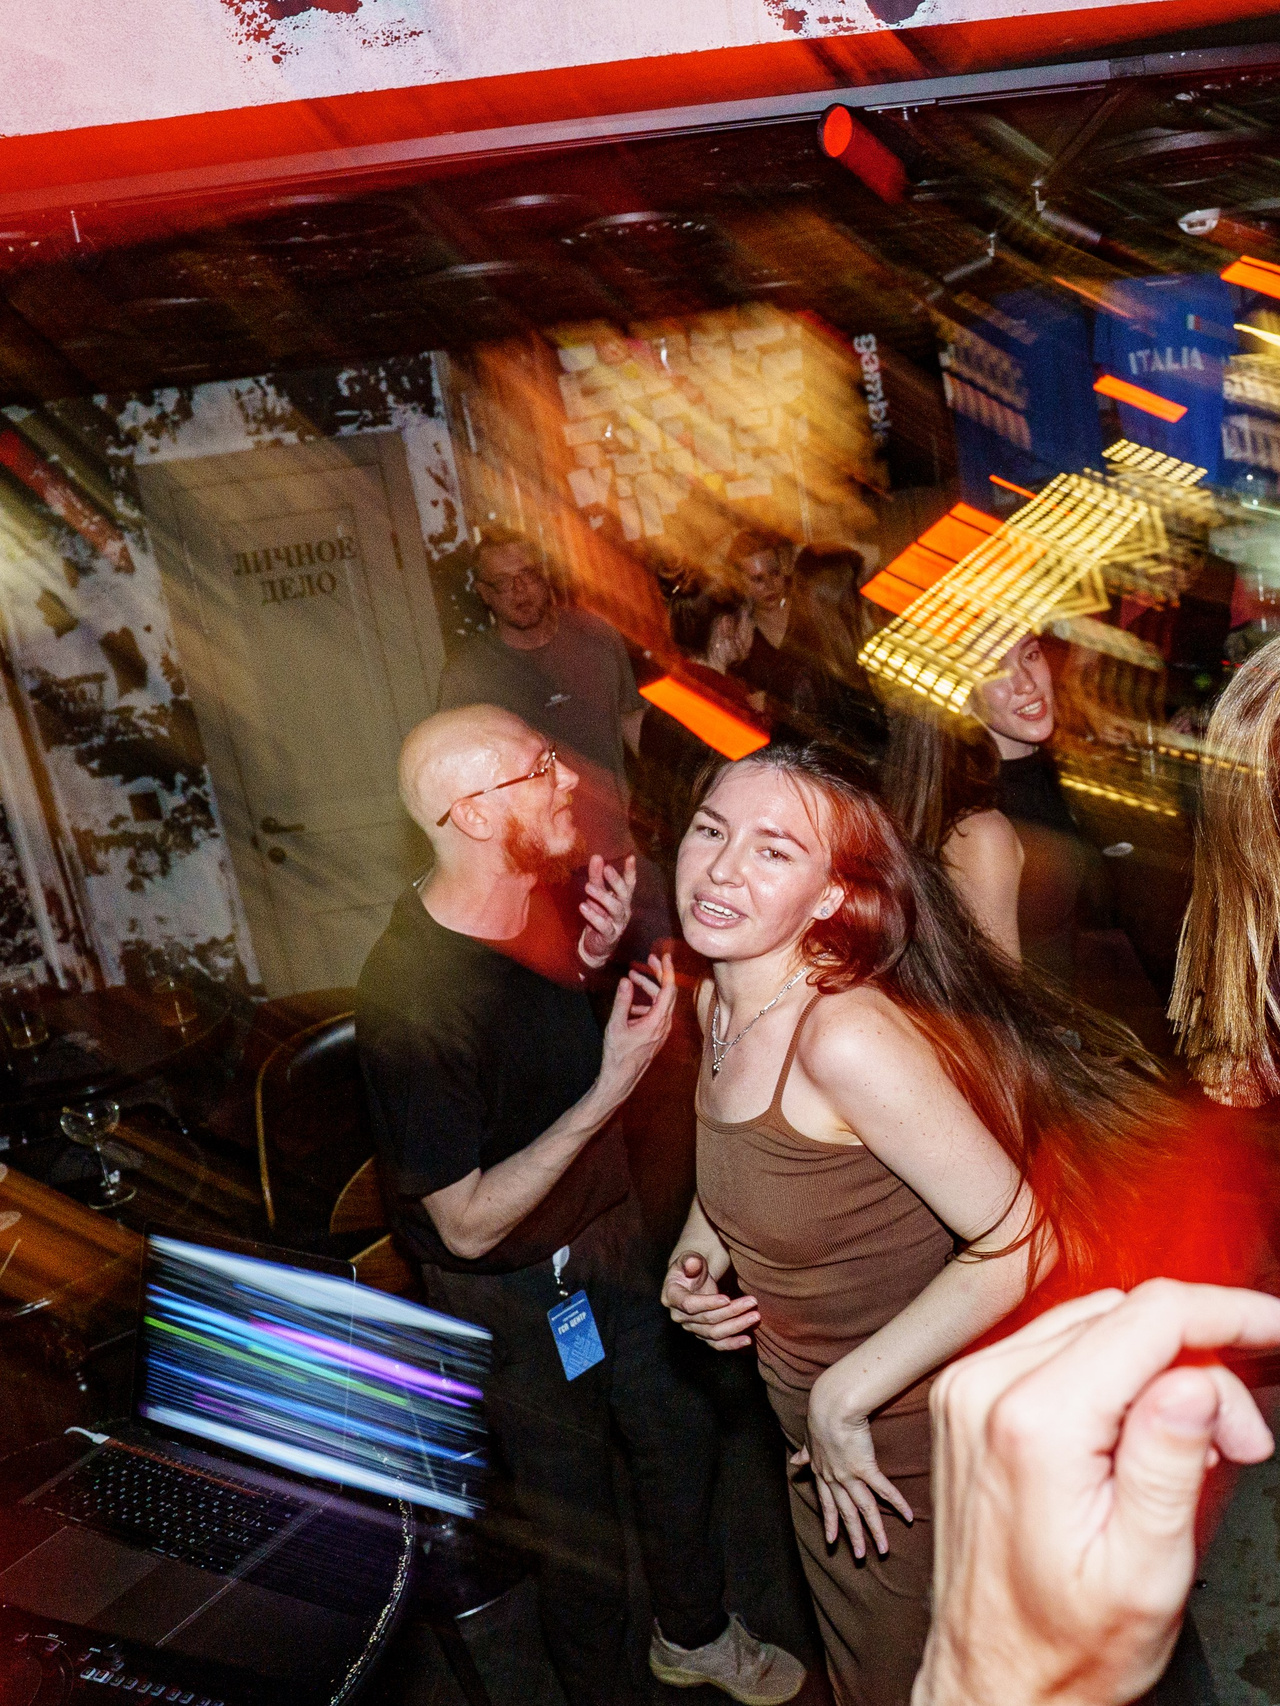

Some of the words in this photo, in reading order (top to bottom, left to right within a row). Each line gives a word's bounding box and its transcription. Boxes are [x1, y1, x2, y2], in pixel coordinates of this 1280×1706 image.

[1128, 346, 1205, 375] ITALIA
[233, 536, 357, 575] ЛИЧНОЕ
[261, 571, 337, 605] ДЕЛО
